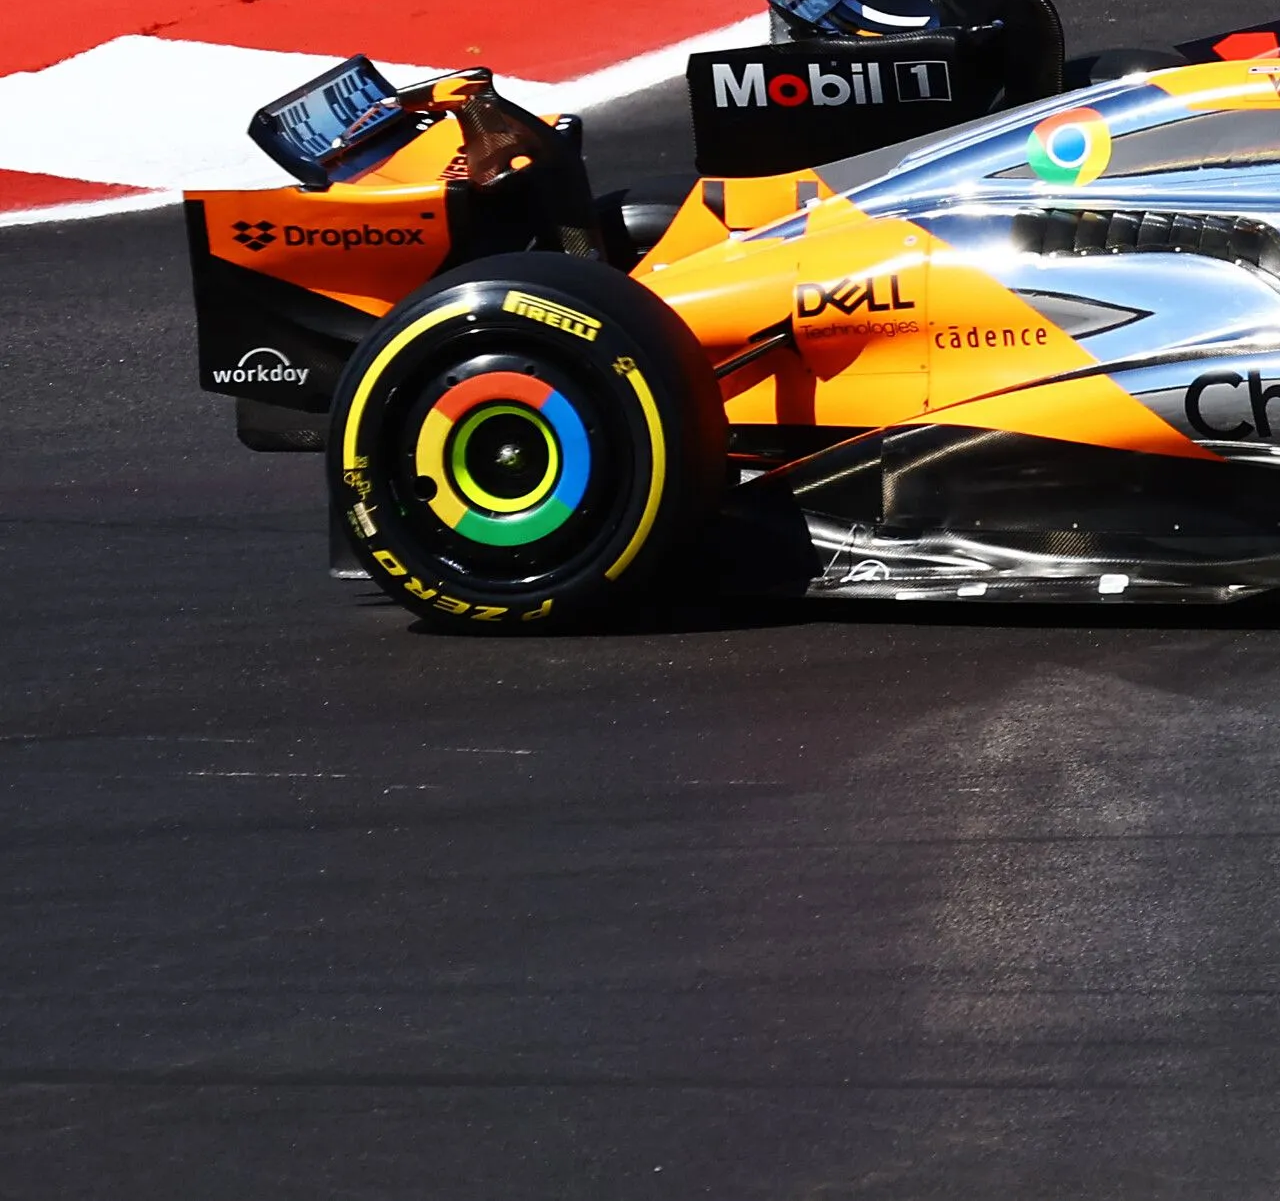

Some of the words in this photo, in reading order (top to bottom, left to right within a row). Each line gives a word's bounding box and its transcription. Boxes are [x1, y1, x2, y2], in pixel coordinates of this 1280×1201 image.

[711, 62, 884, 107] Mobil
[284, 223, 425, 250] Dropbox
[797, 274, 915, 319] DELL
[502, 290, 602, 342] PIRELLI
[799, 319, 919, 340] Technologies
[212, 364, 309, 386] workday
[372, 549, 508, 622] ZERO
[522, 599, 554, 622] P
